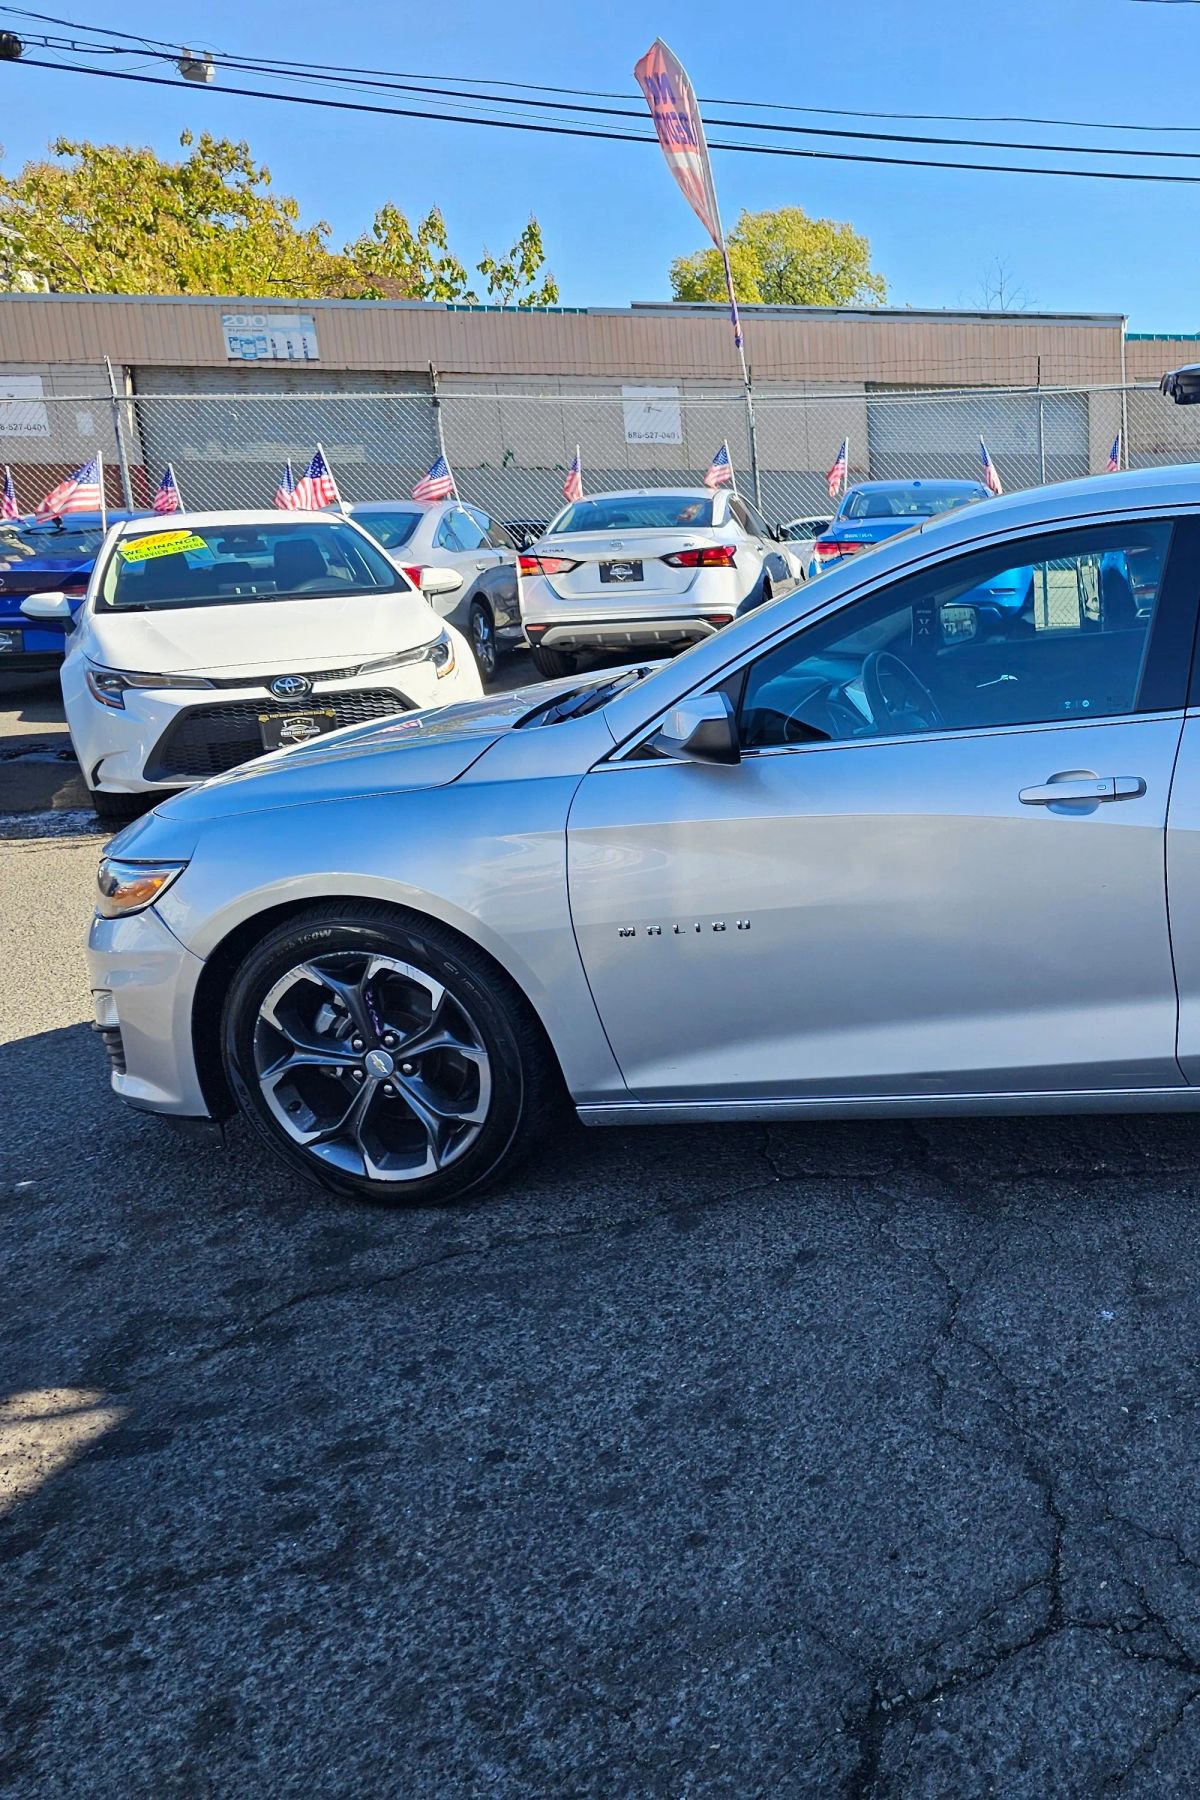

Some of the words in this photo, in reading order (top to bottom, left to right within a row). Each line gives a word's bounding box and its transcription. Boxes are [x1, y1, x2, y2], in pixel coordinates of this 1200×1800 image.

[222, 314, 267, 327] 2010
[147, 537, 199, 551] FINANCE
[617, 919, 751, 937] MALIBU
